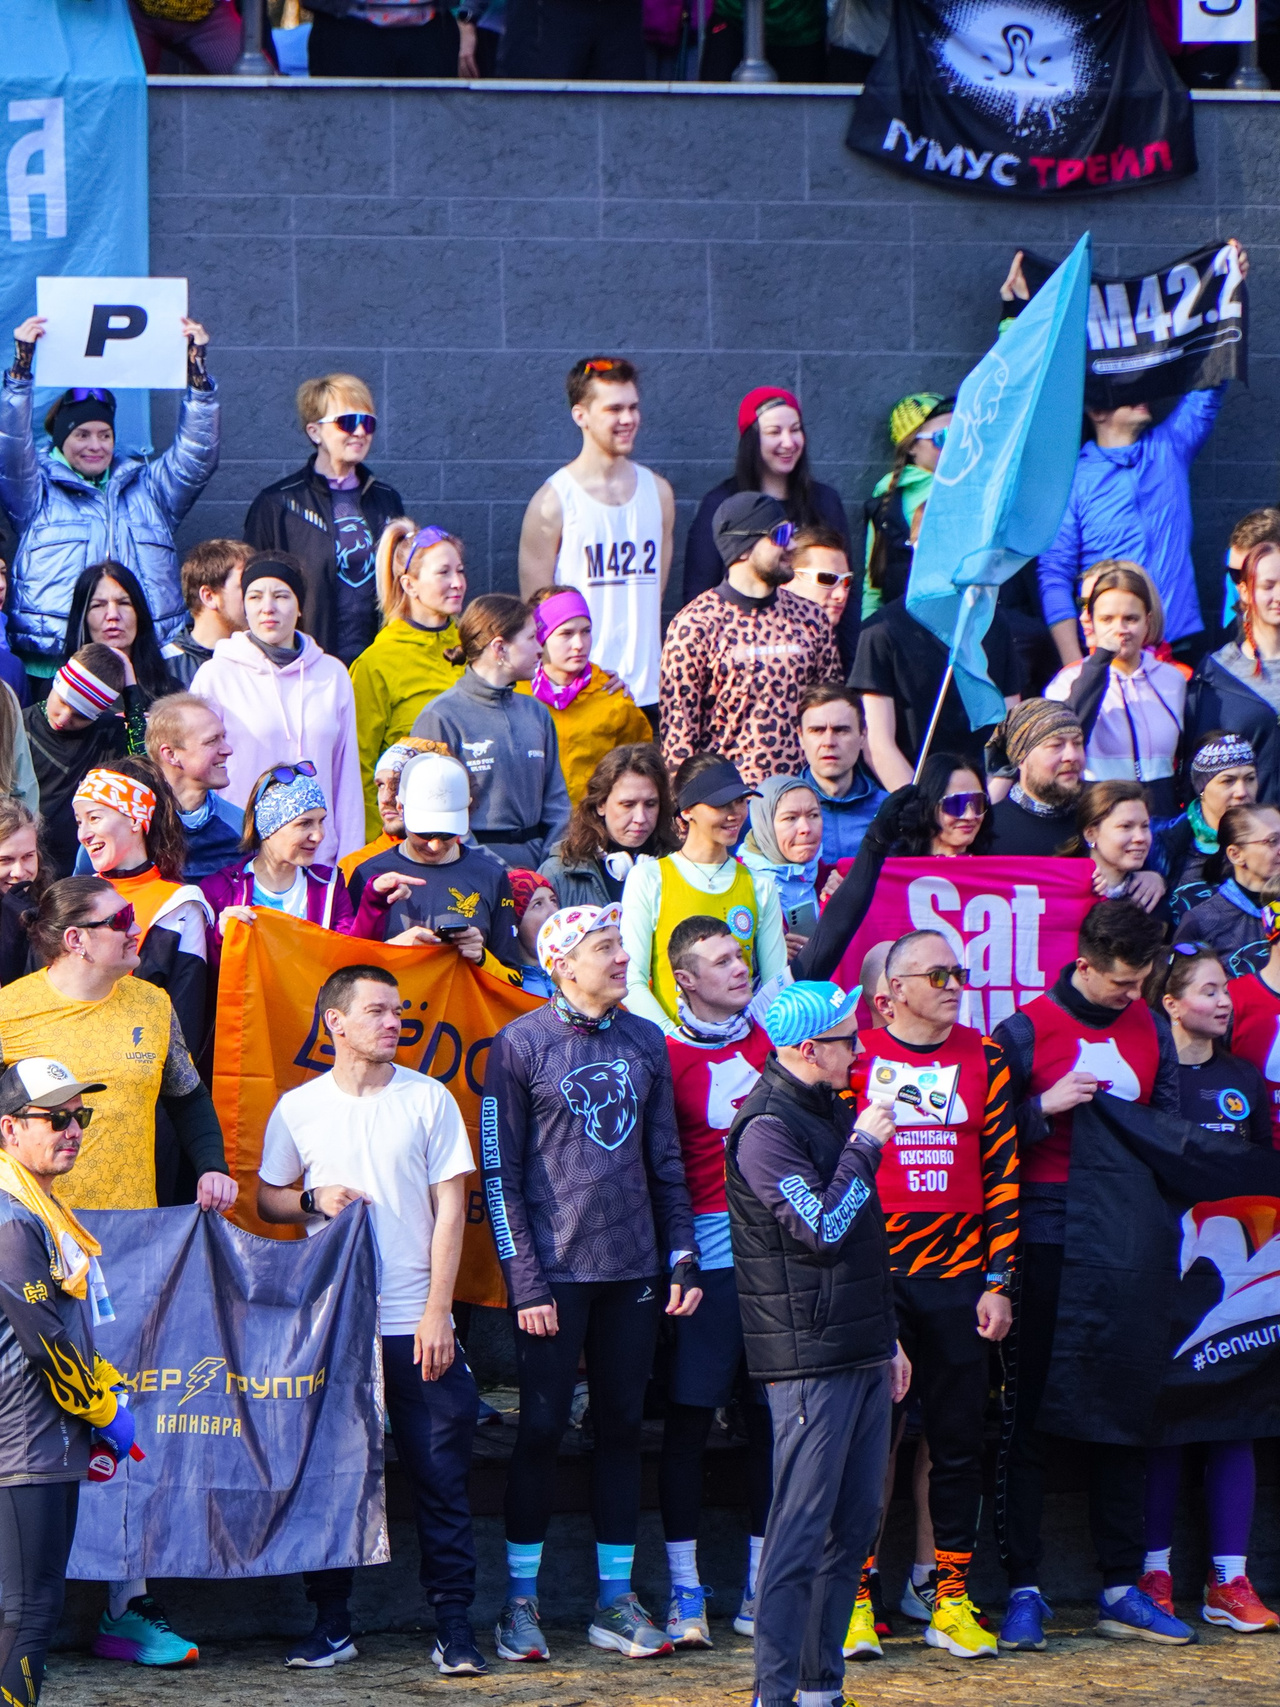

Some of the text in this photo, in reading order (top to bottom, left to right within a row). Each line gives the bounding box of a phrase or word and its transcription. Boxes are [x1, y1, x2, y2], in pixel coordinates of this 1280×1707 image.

[882, 118, 1021, 187] ГУМУС
[1086, 244, 1242, 350] M42.2
[84, 304, 148, 358] P
[584, 540, 657, 579] M42.2
[908, 875, 1046, 988] Sat
[483, 1097, 501, 1170] КУСКОВО
[894, 1130, 958, 1146] КАПИБАРА
[899, 1149, 954, 1166] КУСКОВО
[908, 1170, 948, 1192] 5:00
[156, 1414, 241, 1437] КАПИБАРА
